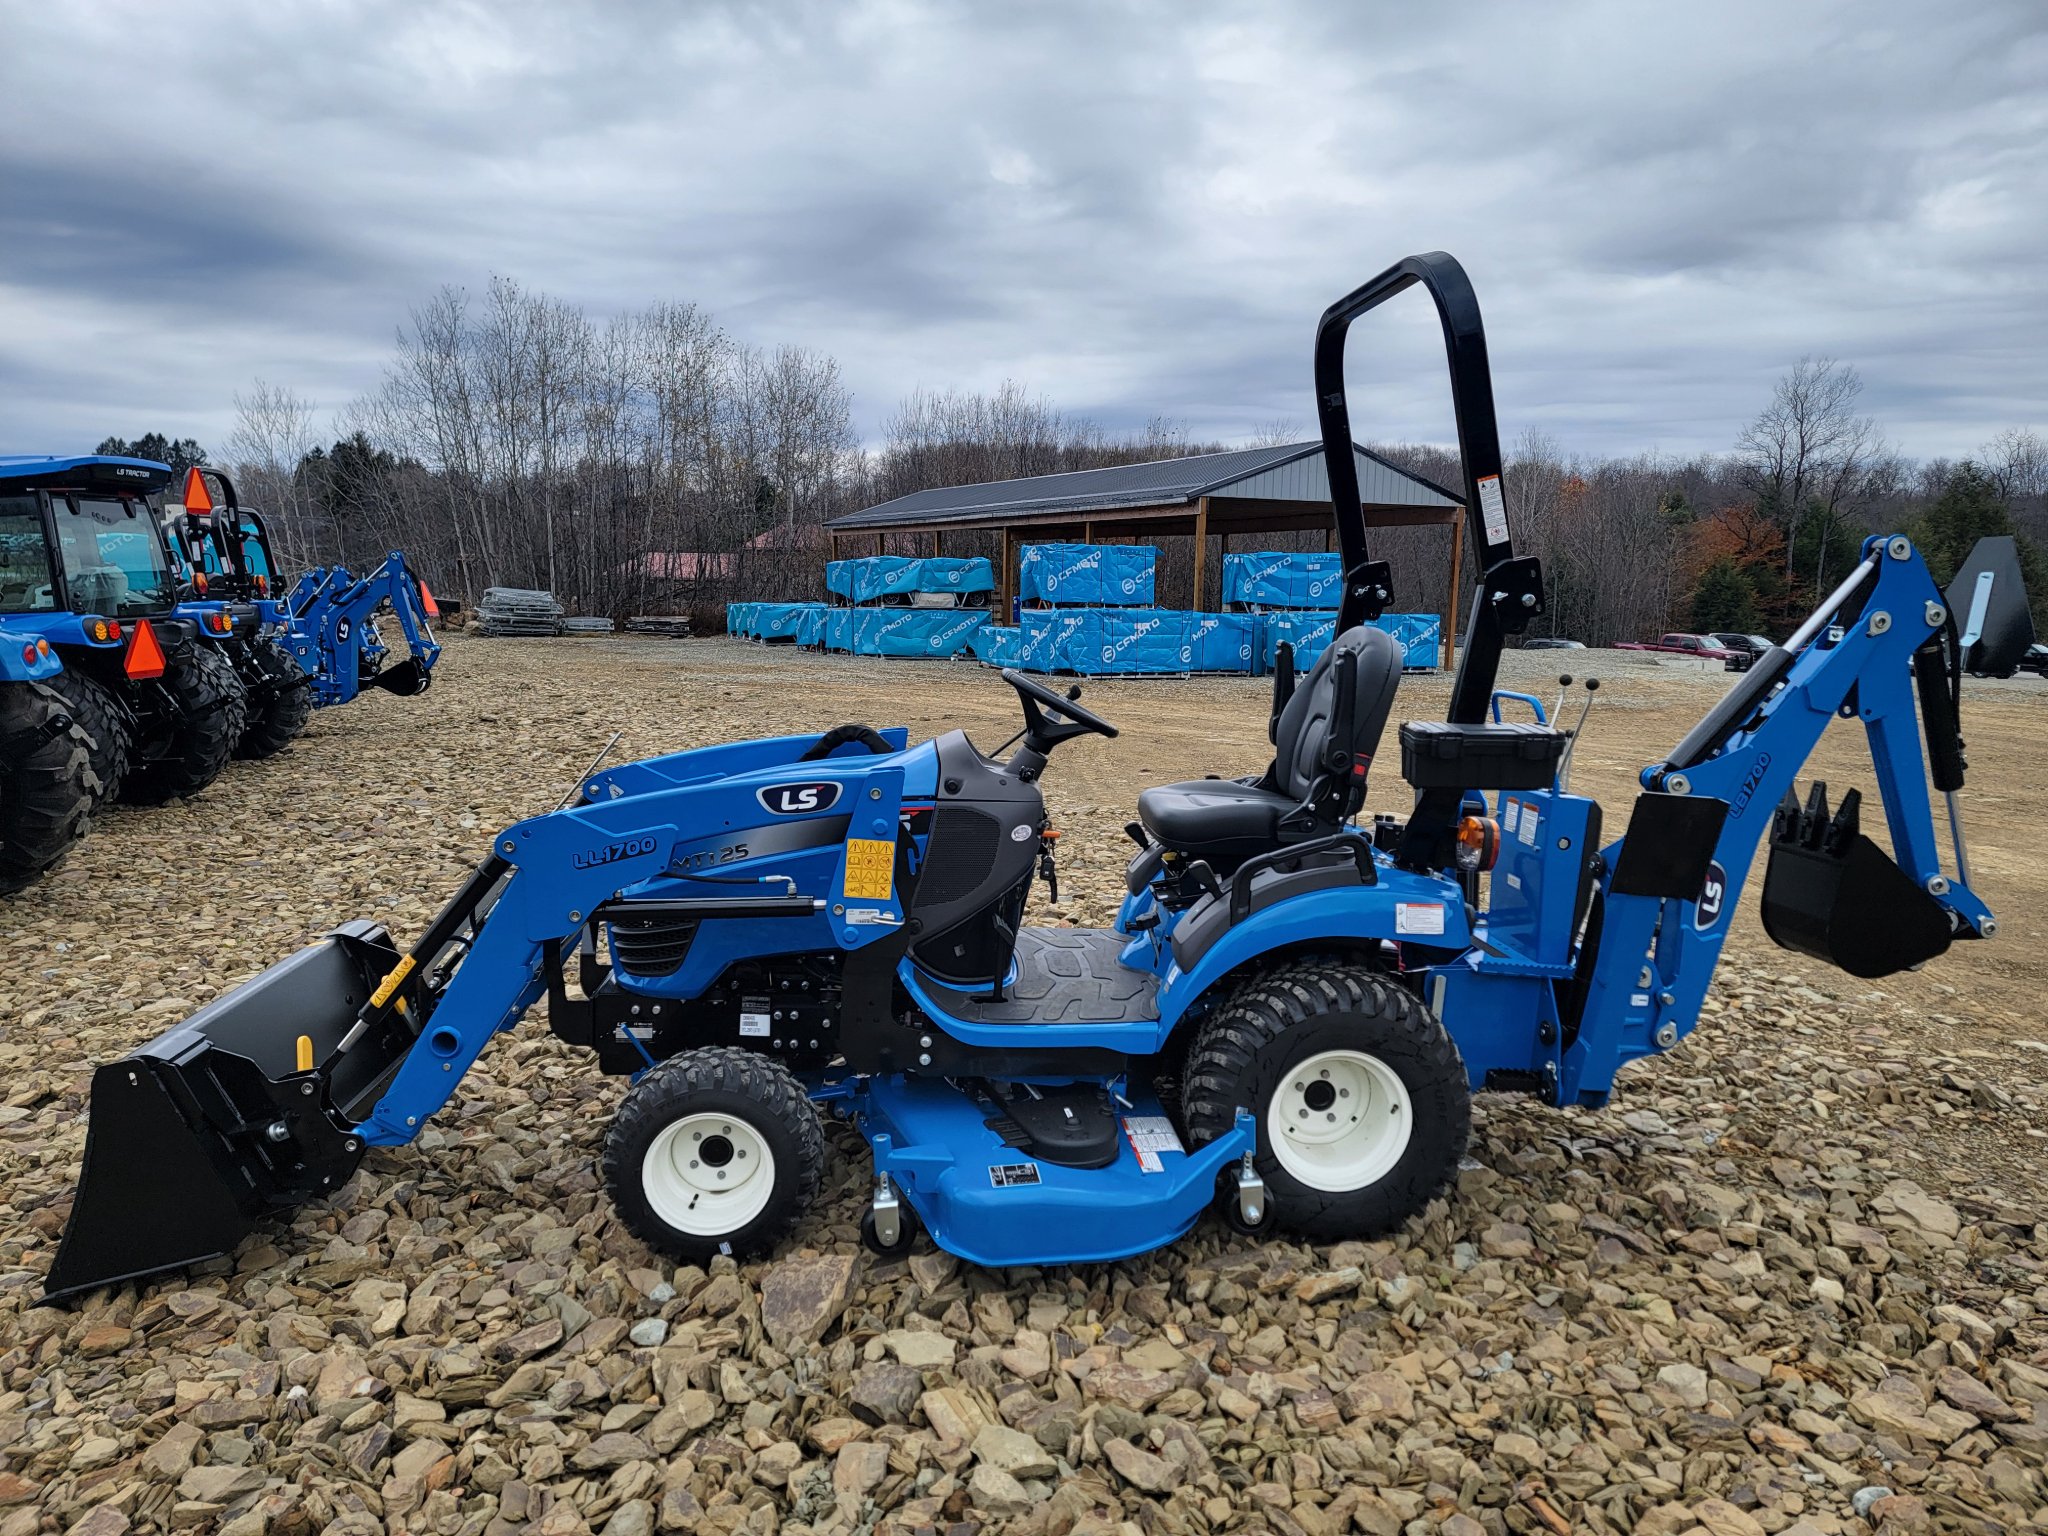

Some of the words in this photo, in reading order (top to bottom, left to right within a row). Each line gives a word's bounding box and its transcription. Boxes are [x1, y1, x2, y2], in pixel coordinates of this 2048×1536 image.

[116, 467, 125, 476] LS
[125, 468, 150, 479] TRACTOR
[1058, 551, 1102, 581] CFMOTO
[1250, 556, 1292, 584] CFMOTO
[339, 622, 349, 639] LS
[941, 615, 978, 641] CFMOTO
[1115, 617, 1161, 652] CFMOTO
[1296, 619, 1337, 649] CFMOTO
[298, 646, 306, 655] LS
[780, 788, 819, 812] LS
[1728, 751, 1772, 820] LB1700
[572, 836, 657, 870] LL1700
[1701, 880, 1723, 914] LS
